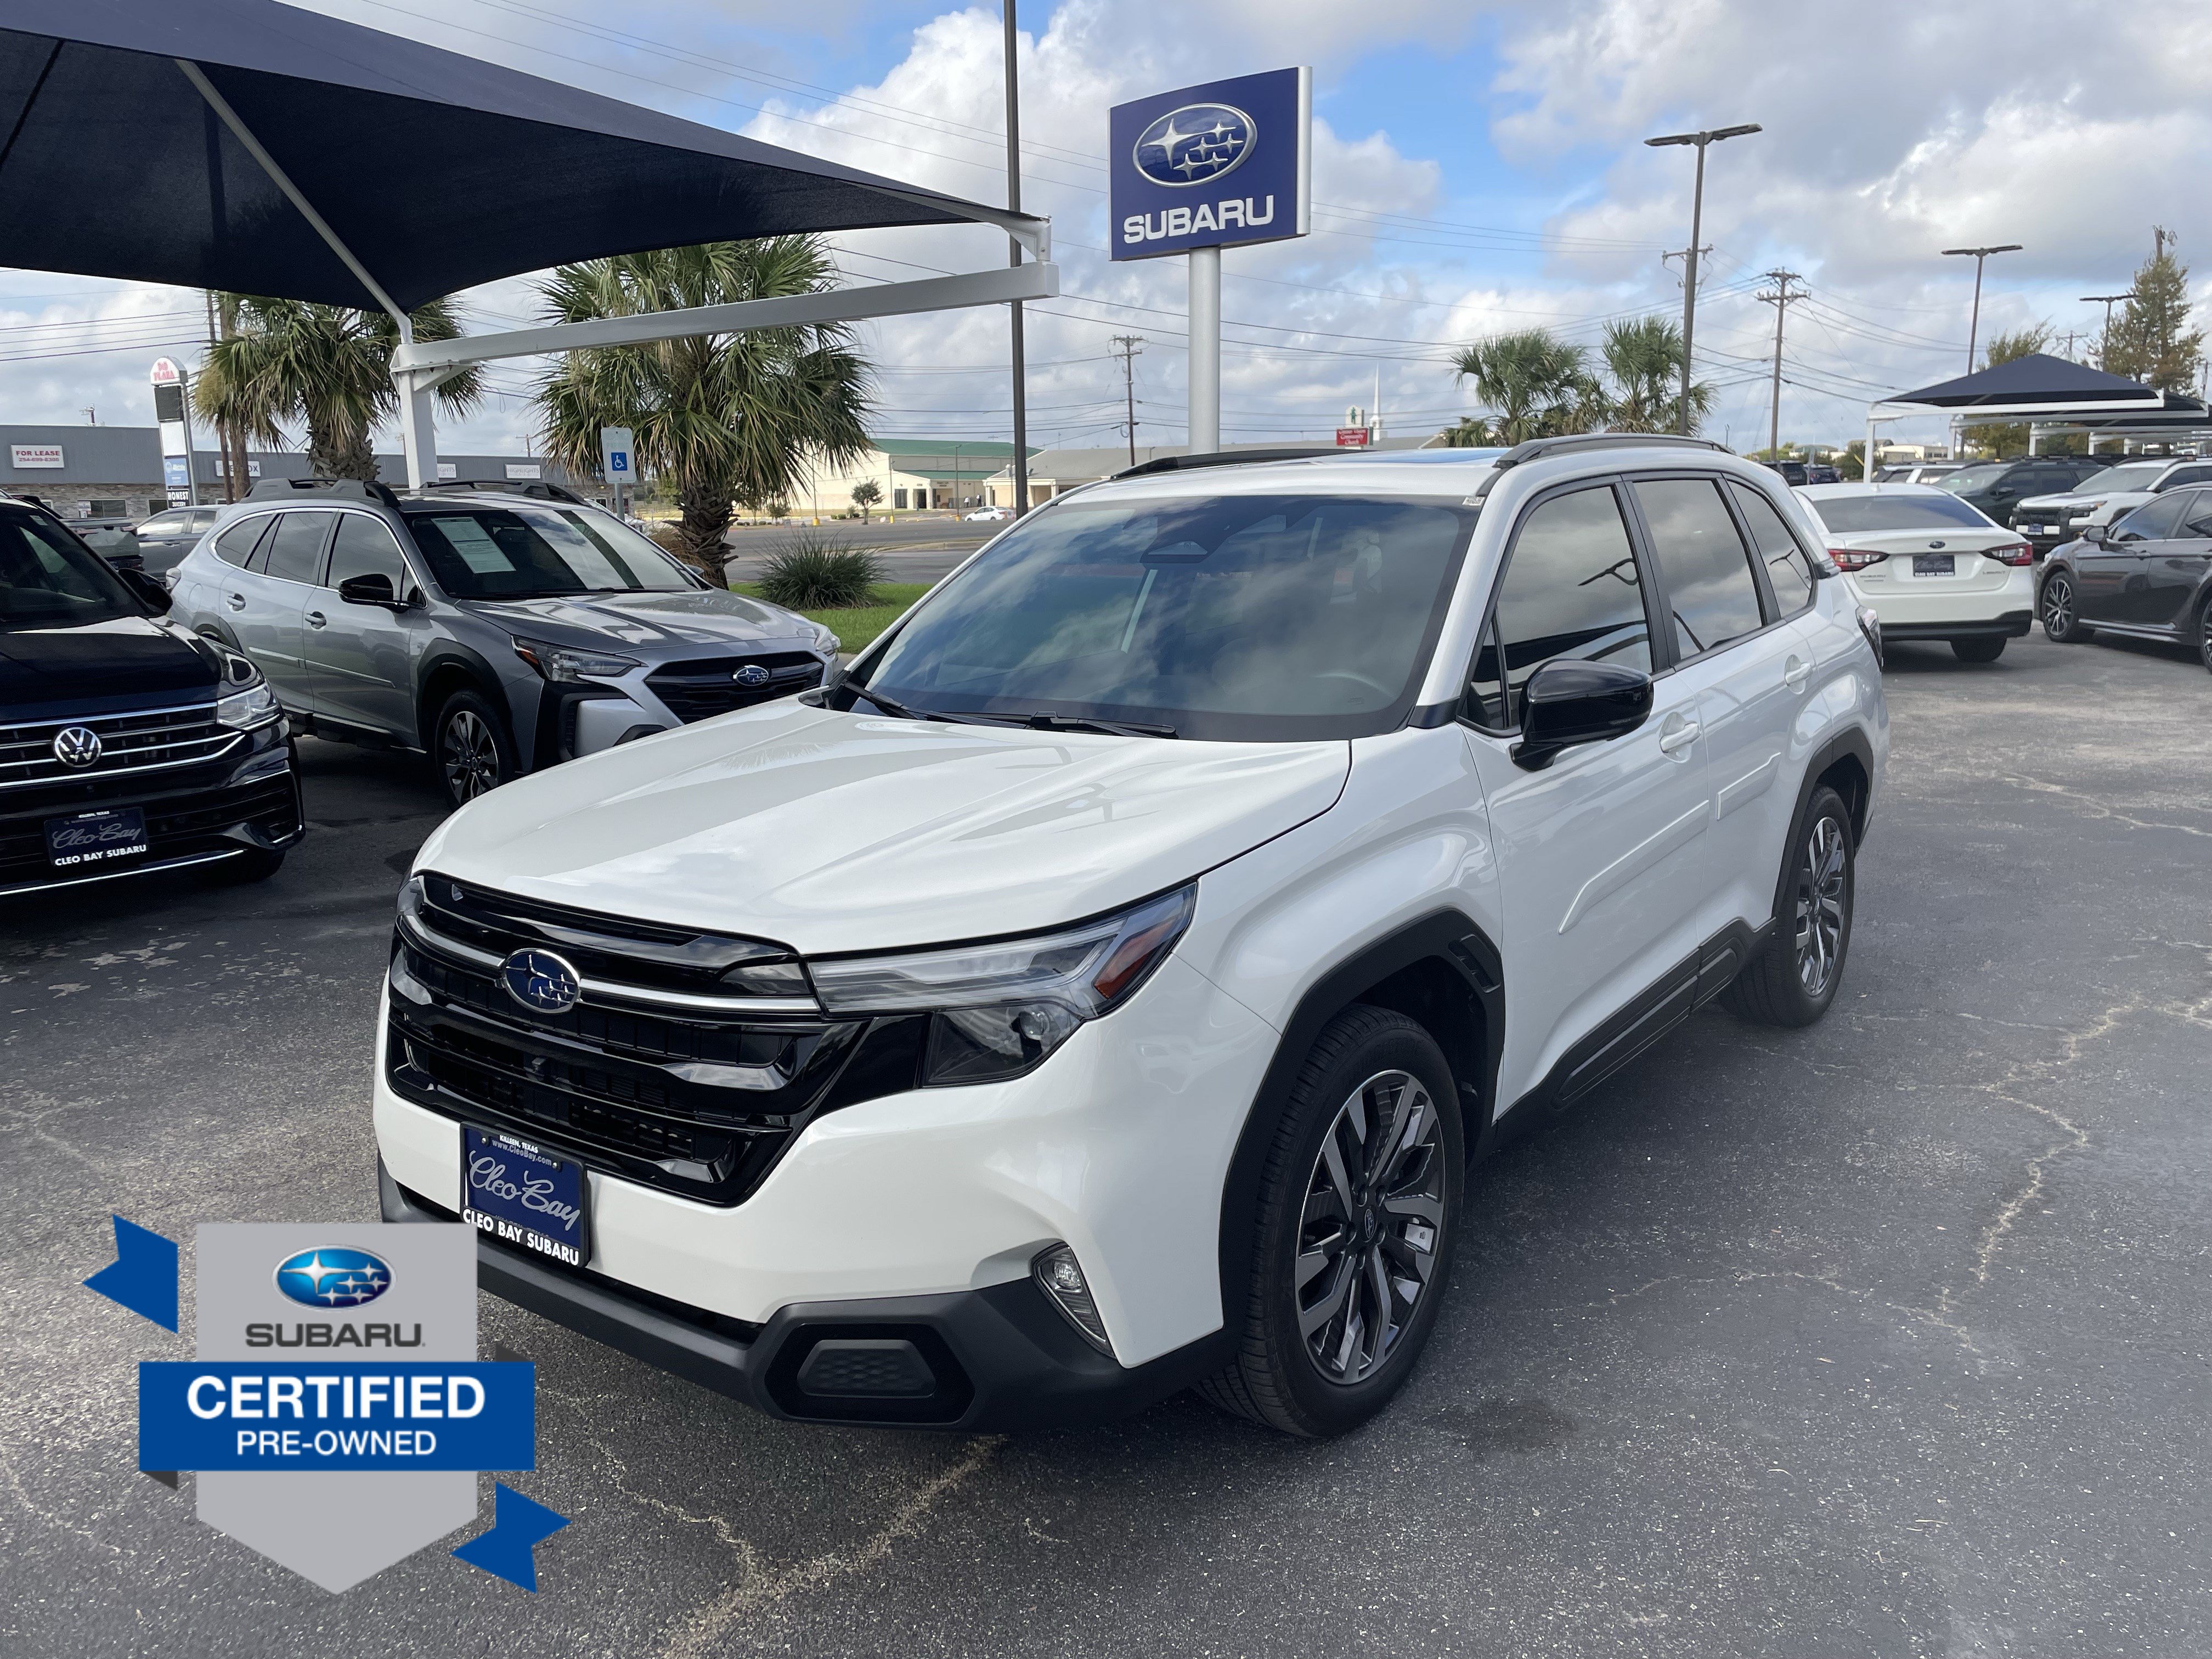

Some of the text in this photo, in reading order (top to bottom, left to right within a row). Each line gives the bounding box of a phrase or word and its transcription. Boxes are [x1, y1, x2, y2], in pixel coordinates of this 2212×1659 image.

[1124, 195, 1274, 244] SUBARU
[167, 491, 189, 500] HONEST
[53, 823, 142, 849] Cleo Bay
[55, 844, 146, 866] CLEO BAY SUBARU
[492, 1139, 552, 1166] www.CleoBay.com
[499, 1135, 539, 1154] KILLEEN, TEXAS
[469, 1150, 522, 1200] Cleo
[521, 1170, 580, 1231] Bay
[462, 1209, 494, 1232] CLEO
[498, 1221, 523, 1243] BAY
[527, 1232, 579, 1266] SUBARU
